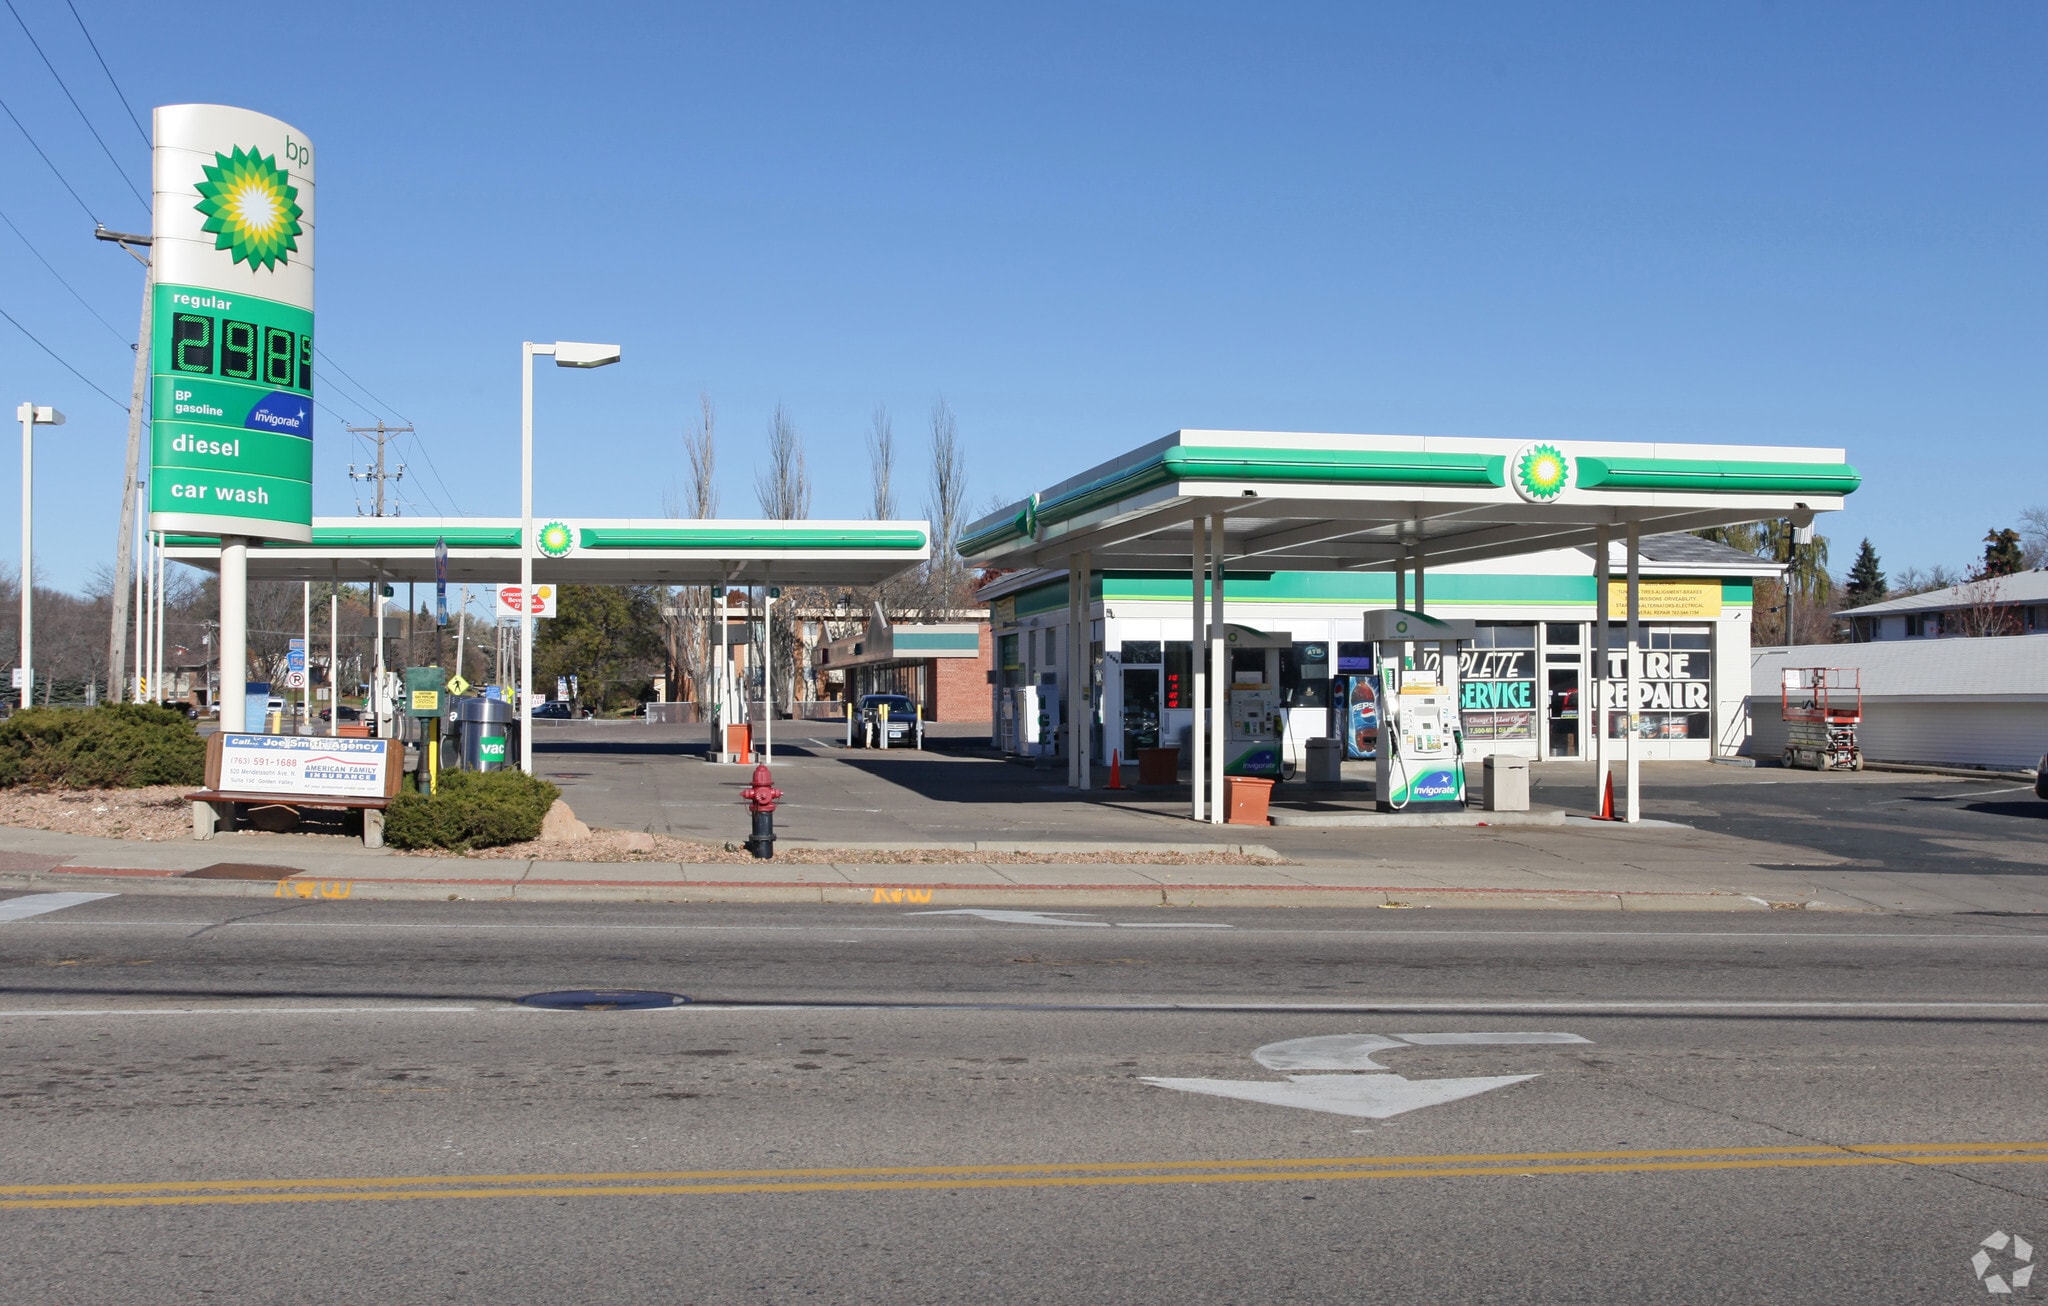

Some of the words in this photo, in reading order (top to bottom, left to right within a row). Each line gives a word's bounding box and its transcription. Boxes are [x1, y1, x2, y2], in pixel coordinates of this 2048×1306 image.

[286, 135, 309, 169] bp
[173, 293, 232, 311] regular
[175, 390, 192, 401] BP
[175, 404, 223, 417] gasoline
[255, 411, 300, 428] Invigorate
[172, 433, 240, 457] diesel
[171, 483, 208, 499] car
[215, 486, 269, 505] wash
[263, 738, 285, 747] Joe
[332, 741, 379, 752] Agency
[481, 744, 505, 754] vac
[253, 757, 297, 767] 591-1688
[1242, 762, 1276, 771] Invigorate
[309, 772, 371, 780] INSURANCE
[349, 766, 377, 774] FAMILY
[1413, 785, 1456, 796] Invigorate
